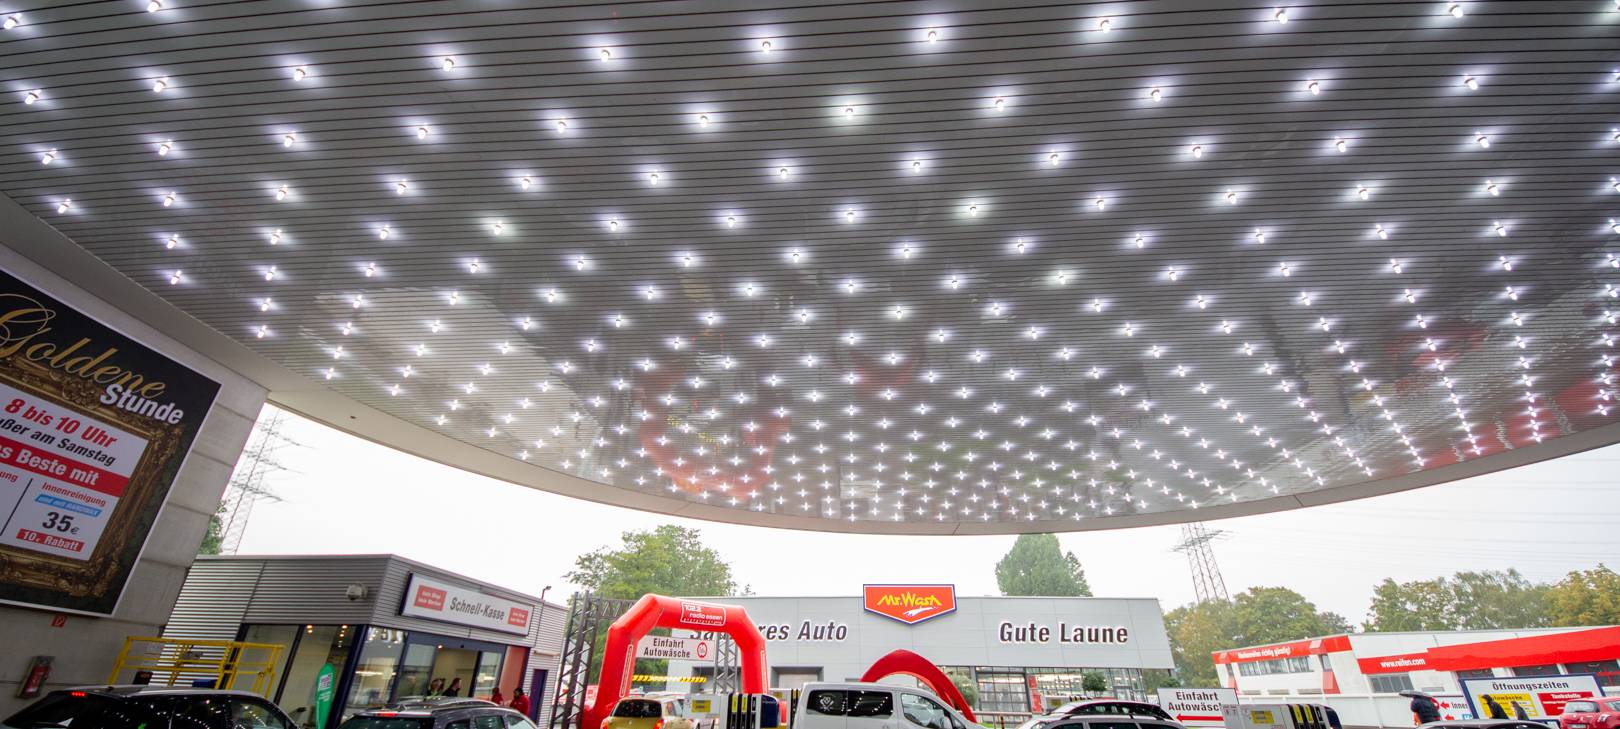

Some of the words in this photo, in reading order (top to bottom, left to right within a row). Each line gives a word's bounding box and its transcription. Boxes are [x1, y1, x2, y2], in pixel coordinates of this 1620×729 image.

[0, 294, 165, 398] Goldene
[100, 384, 183, 424] Stunde
[5, 398, 25, 414] 8
[22, 406, 53, 426] bis
[56, 417, 81, 434] 10
[81, 425, 117, 448] Uhr
[30, 431, 55, 445] am
[57, 438, 116, 467] Samstag
[16, 448, 67, 476] Beste
[69, 468, 99, 486] mit
[42, 482, 106, 508] Innenreinigung
[44, 535, 79, 551] Rabatt
[449, 597, 505, 621] Schnell-Kasse
[797, 619, 848, 642] Auto
[999, 621, 1051, 643] Gute
[1059, 621, 1130, 644] Laune
[643, 647, 691, 658] Autowäsche
[653, 637, 684, 649] Einfahrt
[1175, 690, 1219, 701] Einfahrt
[1492, 681, 1570, 691] Öffnungszeiten
